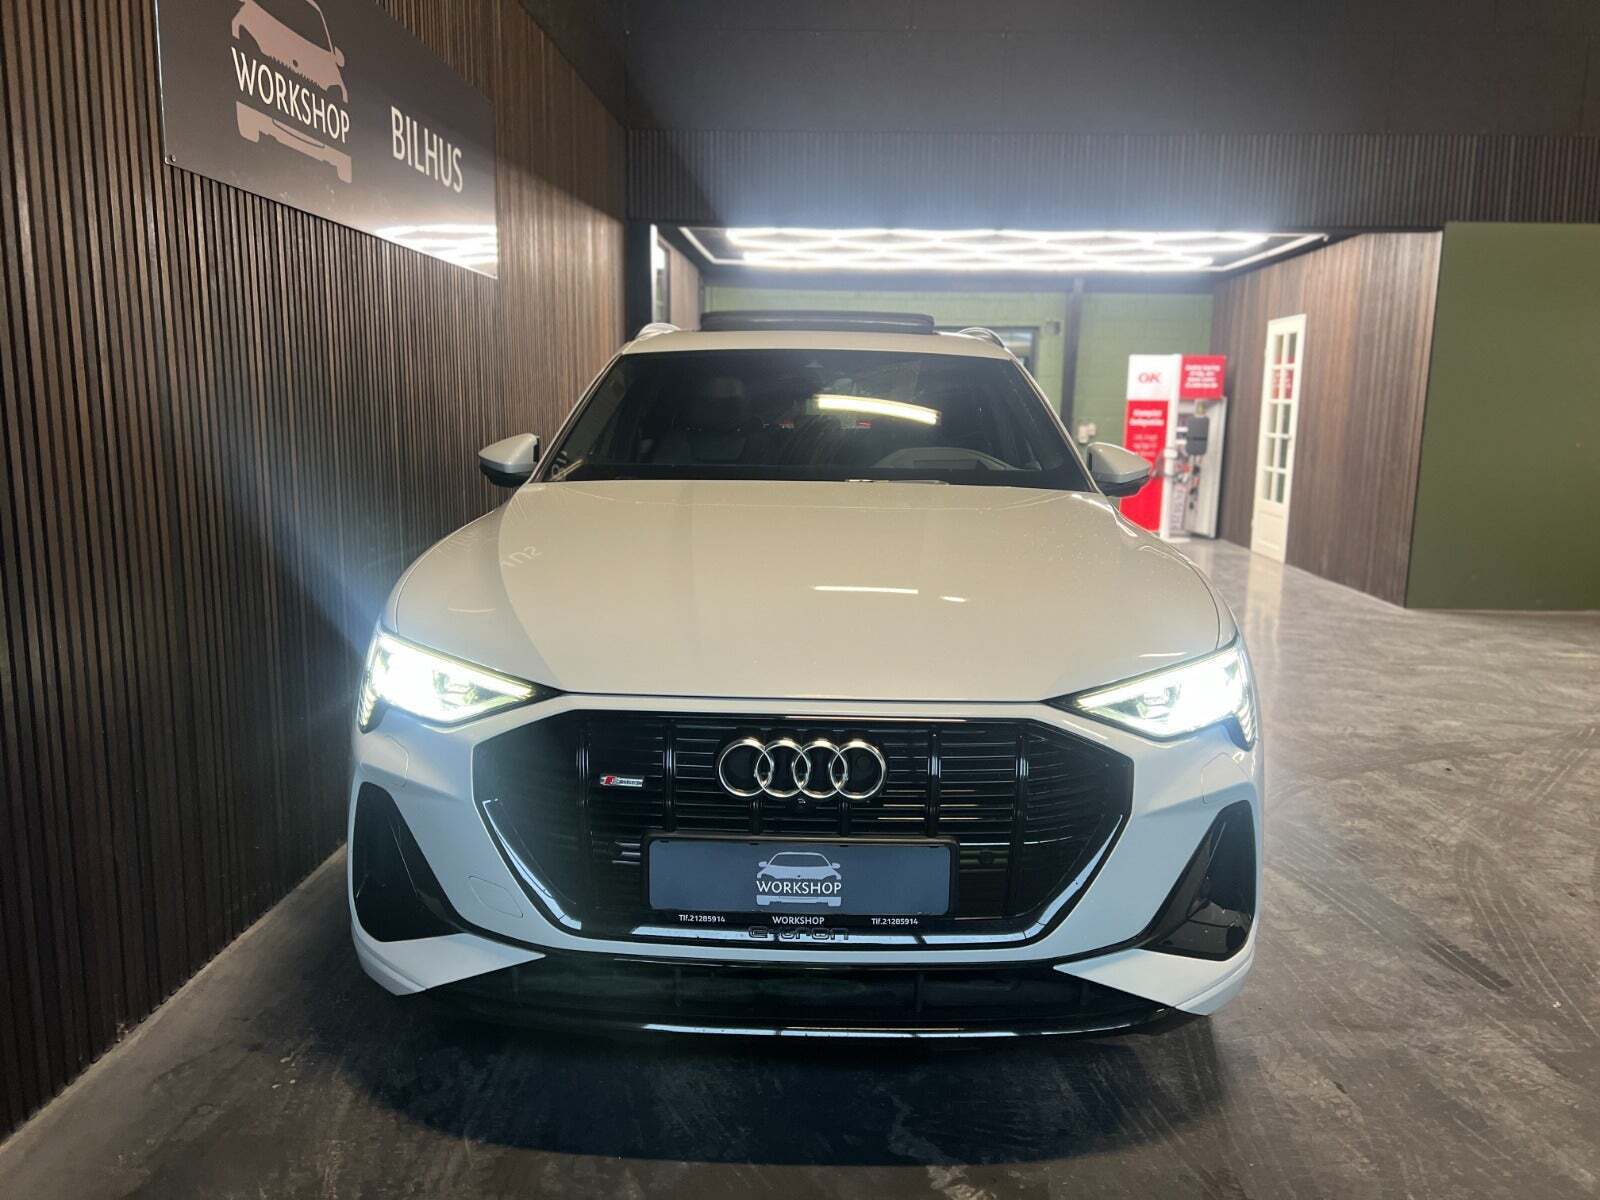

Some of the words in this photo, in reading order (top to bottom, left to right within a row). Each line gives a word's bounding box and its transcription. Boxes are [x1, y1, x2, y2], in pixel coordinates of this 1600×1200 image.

[231, 46, 350, 144] WORKSHOP
[391, 105, 463, 194] BILHUS
[756, 880, 842, 895] WORKSHOP
[772, 916, 825, 925] WORKSHOP
